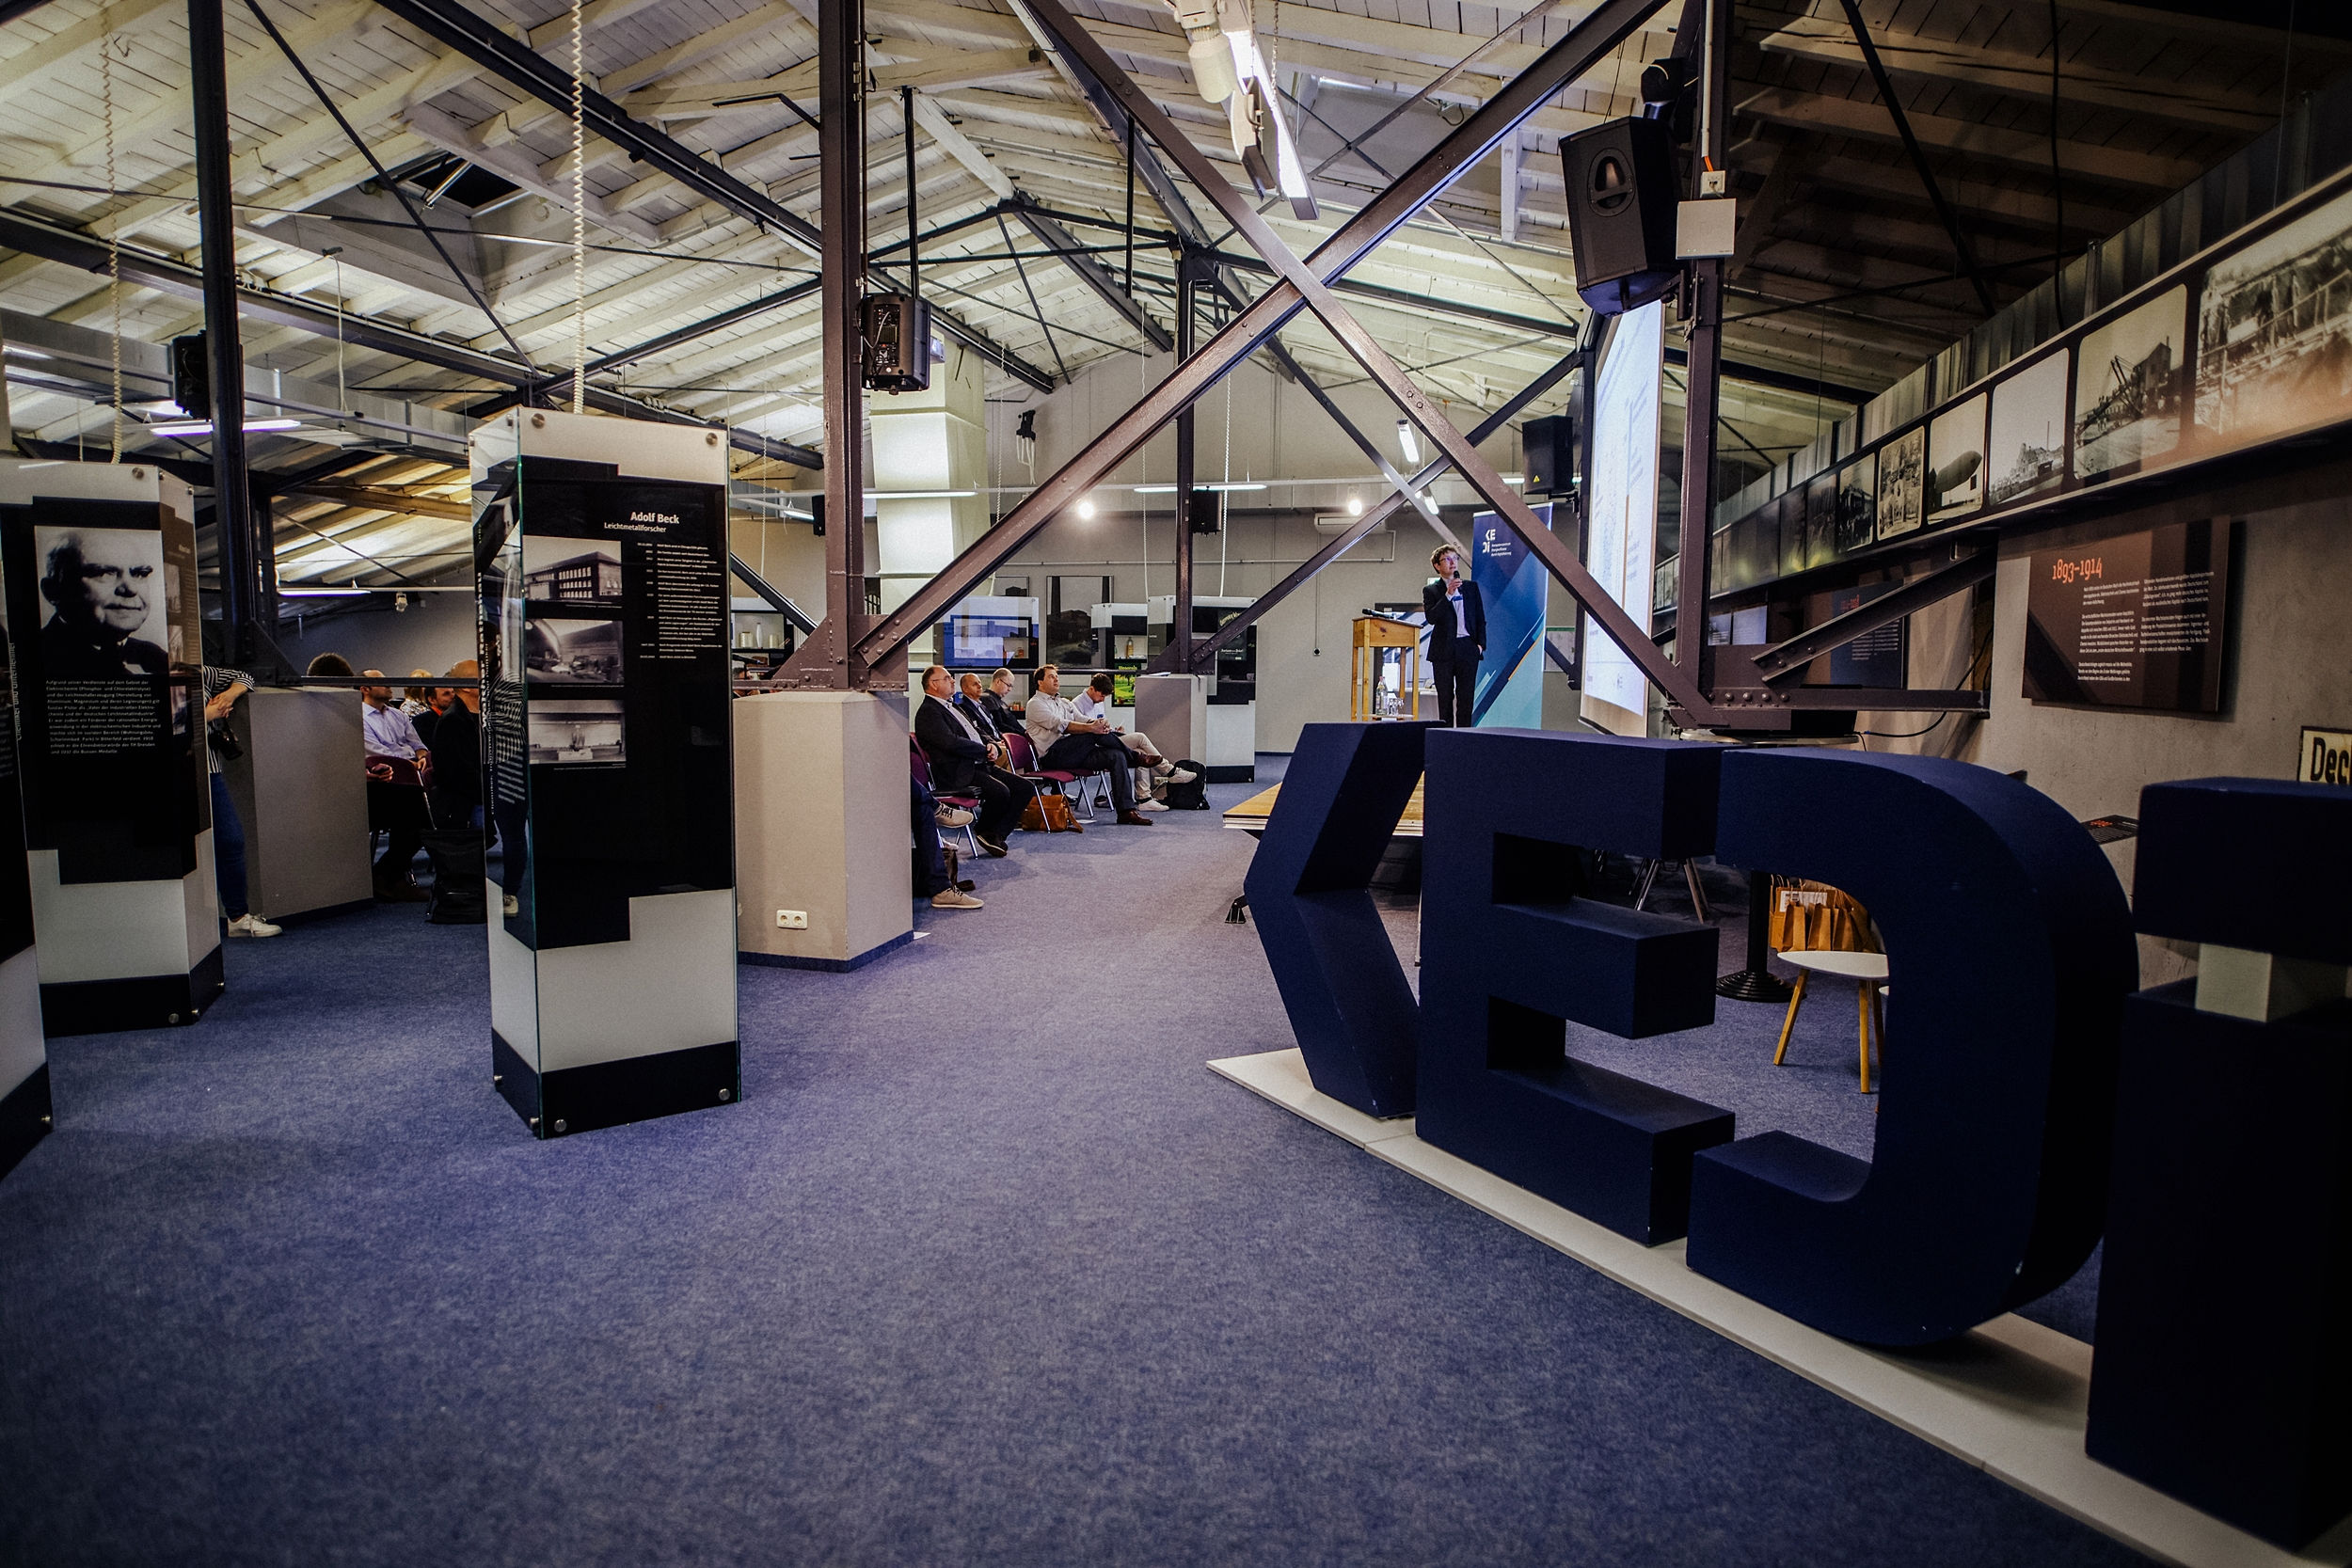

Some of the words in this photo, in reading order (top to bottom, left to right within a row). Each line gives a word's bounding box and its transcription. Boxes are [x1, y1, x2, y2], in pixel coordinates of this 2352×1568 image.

[630, 511, 656, 523] Adolf
[657, 514, 680, 524] Beck
[604, 522, 667, 533] Leichtmetallforscher
[2310, 736, 2352, 784] Dec
